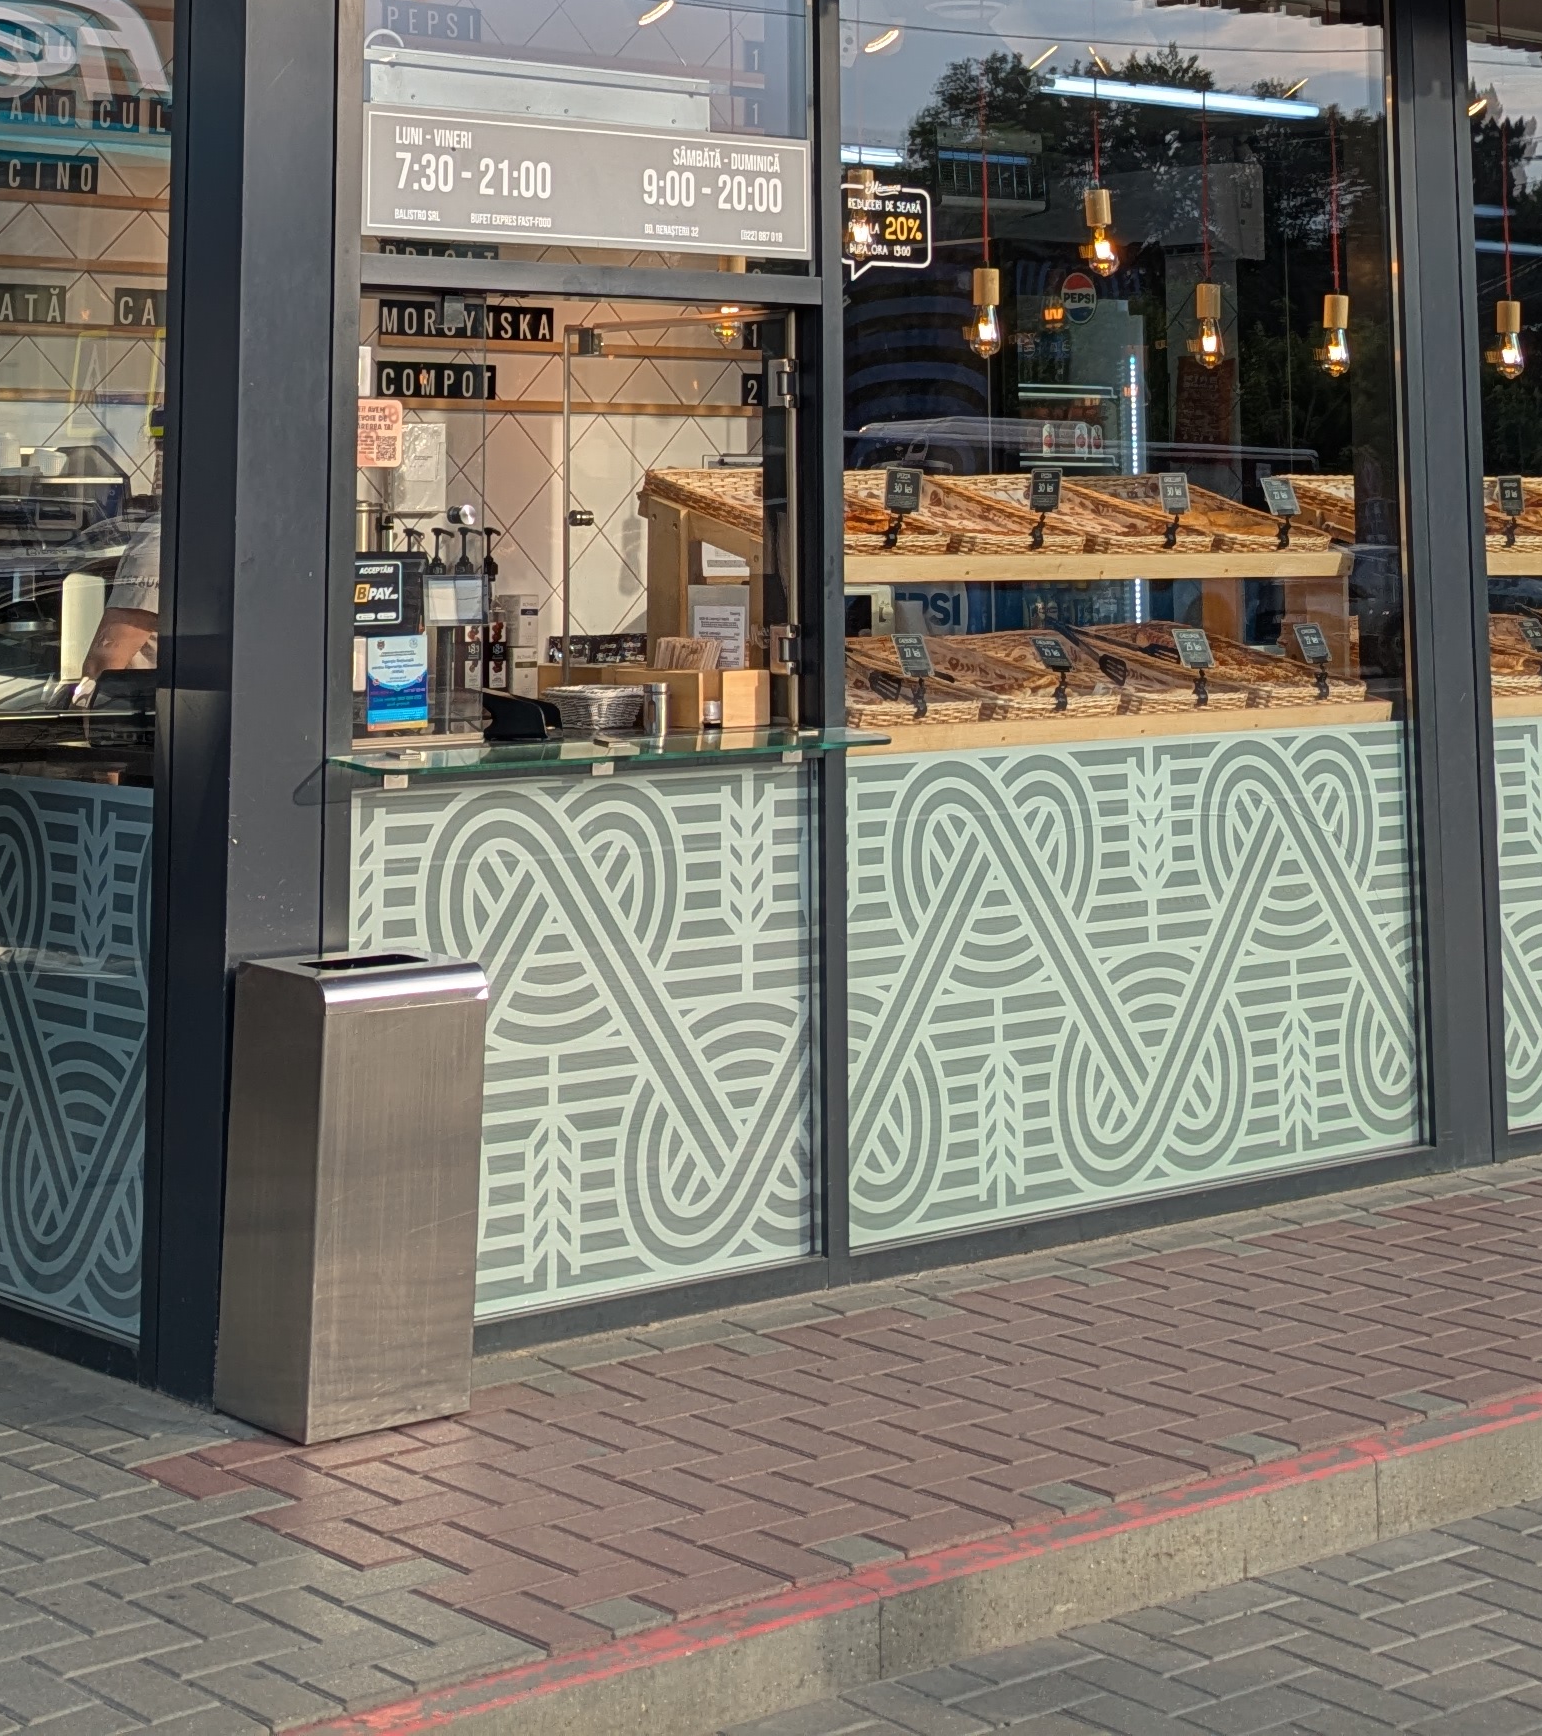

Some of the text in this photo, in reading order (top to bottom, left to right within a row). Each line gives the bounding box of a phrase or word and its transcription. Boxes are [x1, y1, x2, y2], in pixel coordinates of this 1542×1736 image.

[386, 5, 477, 41] PEPSI
[99, 98, 135, 130] CU
[395, 125, 423, 146] LUNI
[433, 128, 472, 149] VINERI
[672, 145, 722, 169] SÂMBĂTĂ
[730, 152, 781, 173] DUMINICĂ
[395, 151, 454, 193] 7:30
[479, 157, 552, 199] 21:00
[642, 168, 695, 208] 9:00
[717, 174, 782, 214] 20:00
[470, 212, 491, 225] BUFET
[491, 214, 517, 226] EXPRES
[517, 215, 552, 228] FAST-FOOD
[885, 200, 895, 212] DE
[896, 200, 922, 214] SEARĂ
[885, 216, 923, 241] 20%
[870, 244, 889, 256] ORA
[1063, 292, 1095, 304] PEPSI
[381, 367, 492, 398] COMPOT
